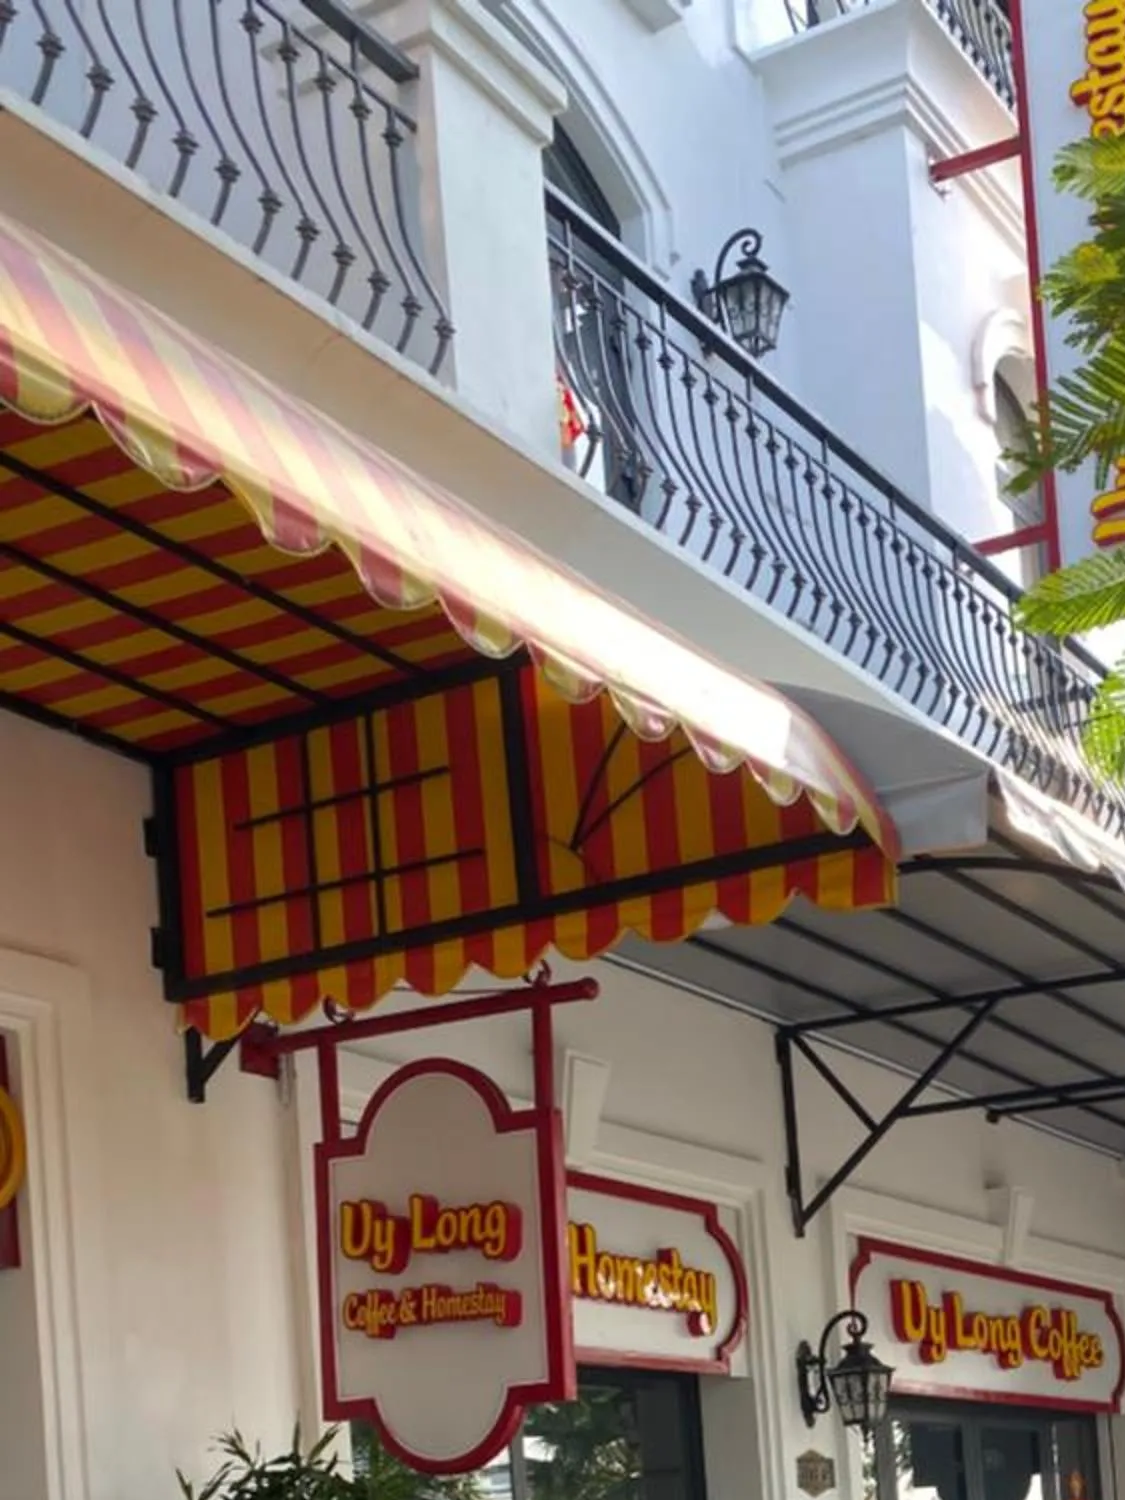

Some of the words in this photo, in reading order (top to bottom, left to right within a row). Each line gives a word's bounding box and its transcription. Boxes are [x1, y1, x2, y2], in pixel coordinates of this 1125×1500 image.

[340, 1200, 403, 1273] Uy
[409, 1193, 515, 1260] Long
[343, 1289, 396, 1338] Coffee
[399, 1290, 417, 1325] &
[421, 1284, 510, 1326] Homestay
[567, 1221, 718, 1336] Homestay
[893, 1279, 947, 1364] Uy
[946, 1290, 1023, 1368] Long
[1023, 1304, 1104, 1380] Coffee
